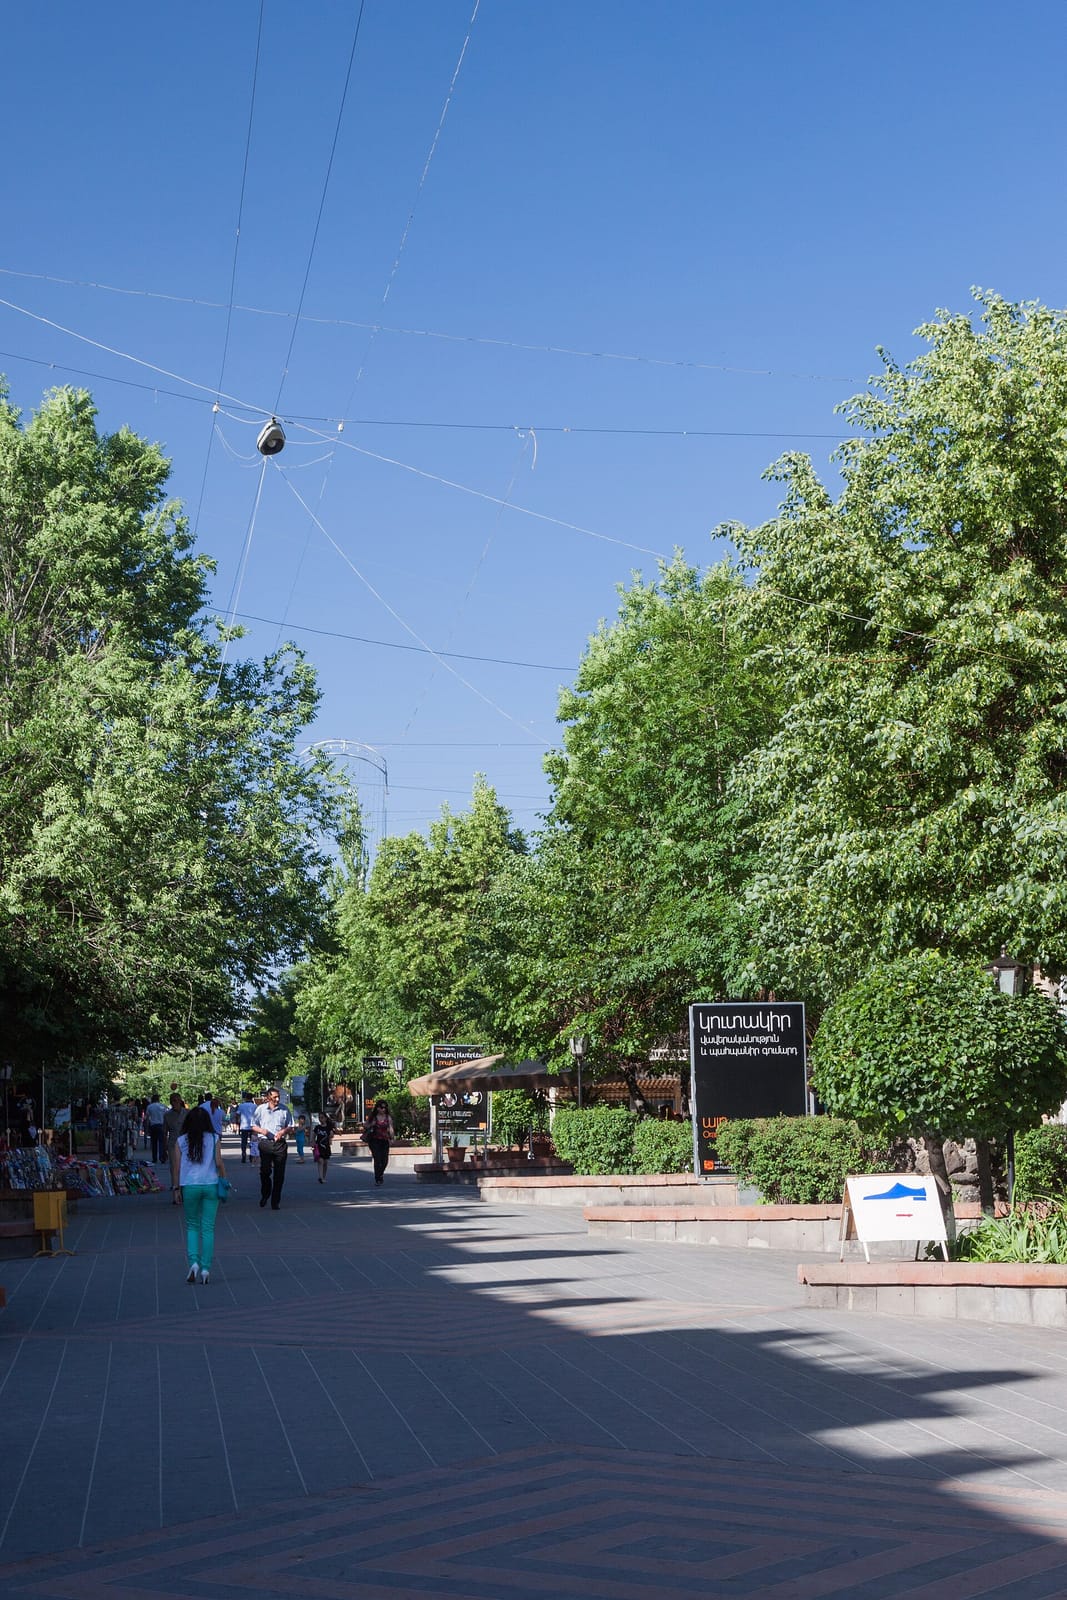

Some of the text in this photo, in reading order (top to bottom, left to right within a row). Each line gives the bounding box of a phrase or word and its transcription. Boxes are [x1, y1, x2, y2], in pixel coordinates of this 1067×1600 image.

[699, 1011, 791, 1033] կուտակիր
[700, 1034, 780, 1046] վավերականություն
[709, 1046, 760, 1057] պահպանիր
[761, 1045, 798, 1057] գումարդ
